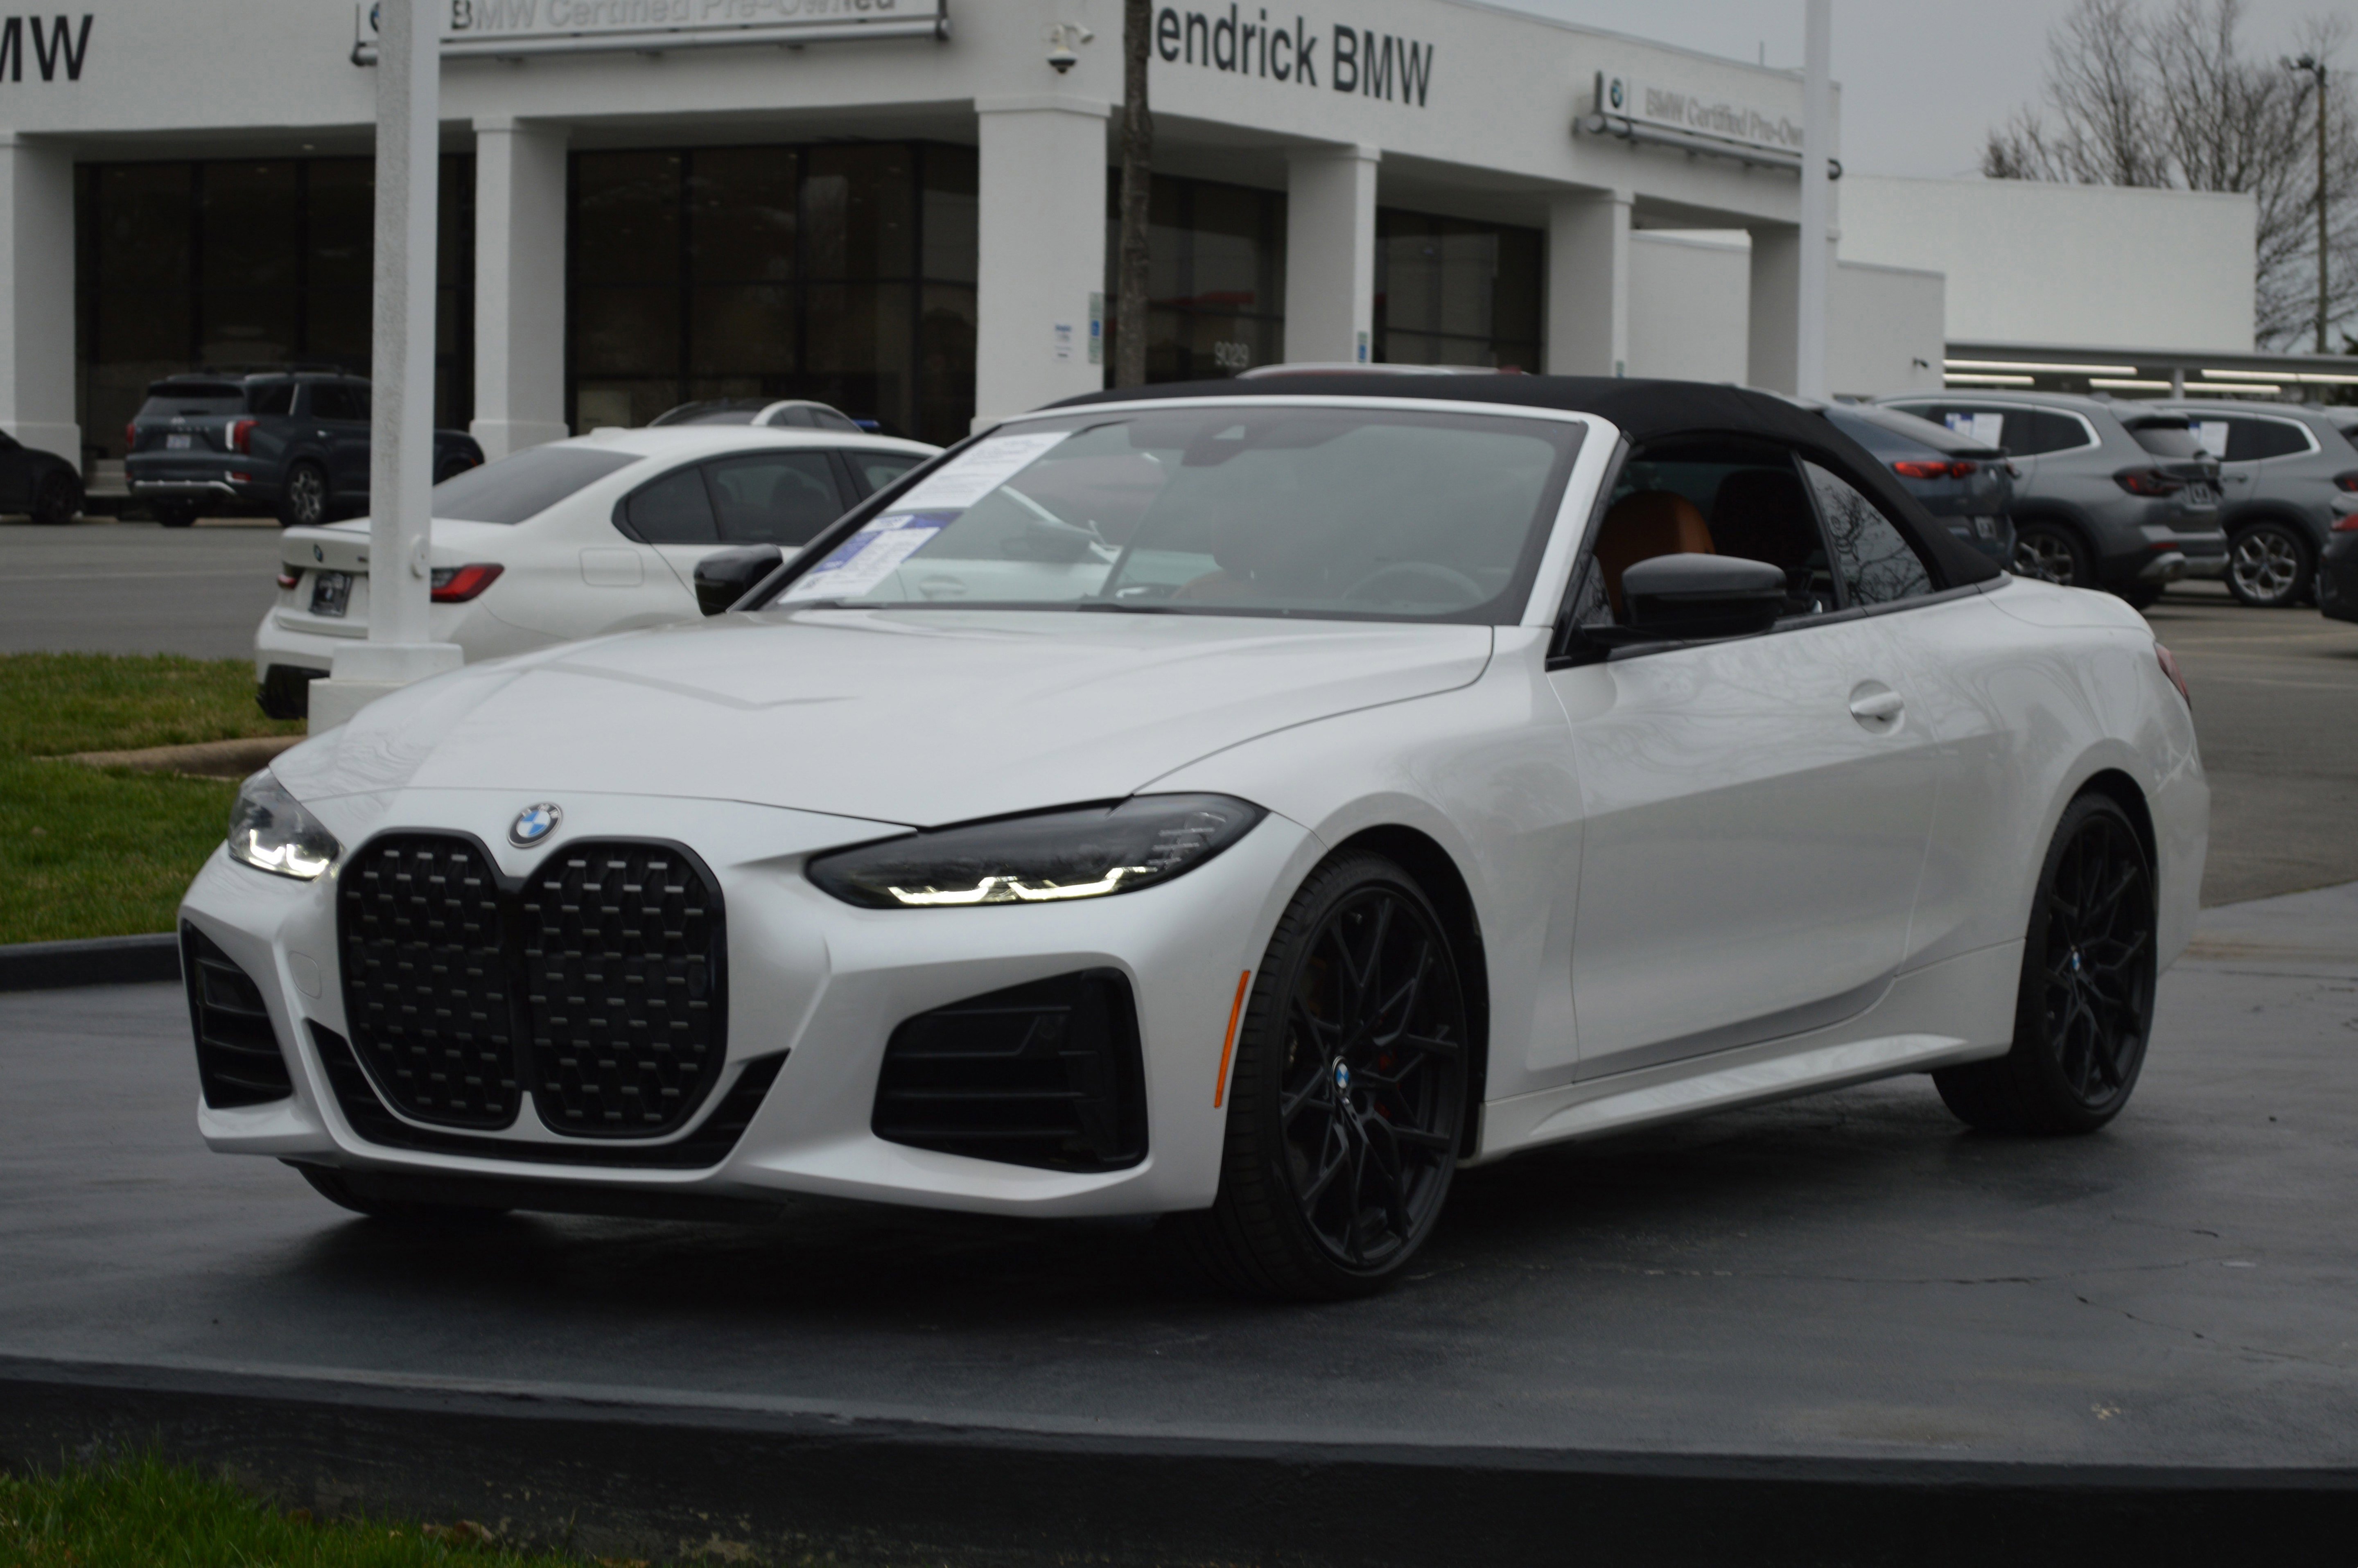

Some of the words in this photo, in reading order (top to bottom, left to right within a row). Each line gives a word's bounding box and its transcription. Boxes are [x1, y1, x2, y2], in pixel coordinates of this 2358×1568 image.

[451, 0, 536, 30] BMW
[549, 0, 691, 27] Certified
[1147, 0, 1317, 87] endrick
[1333, 24, 1433, 107] BMW
